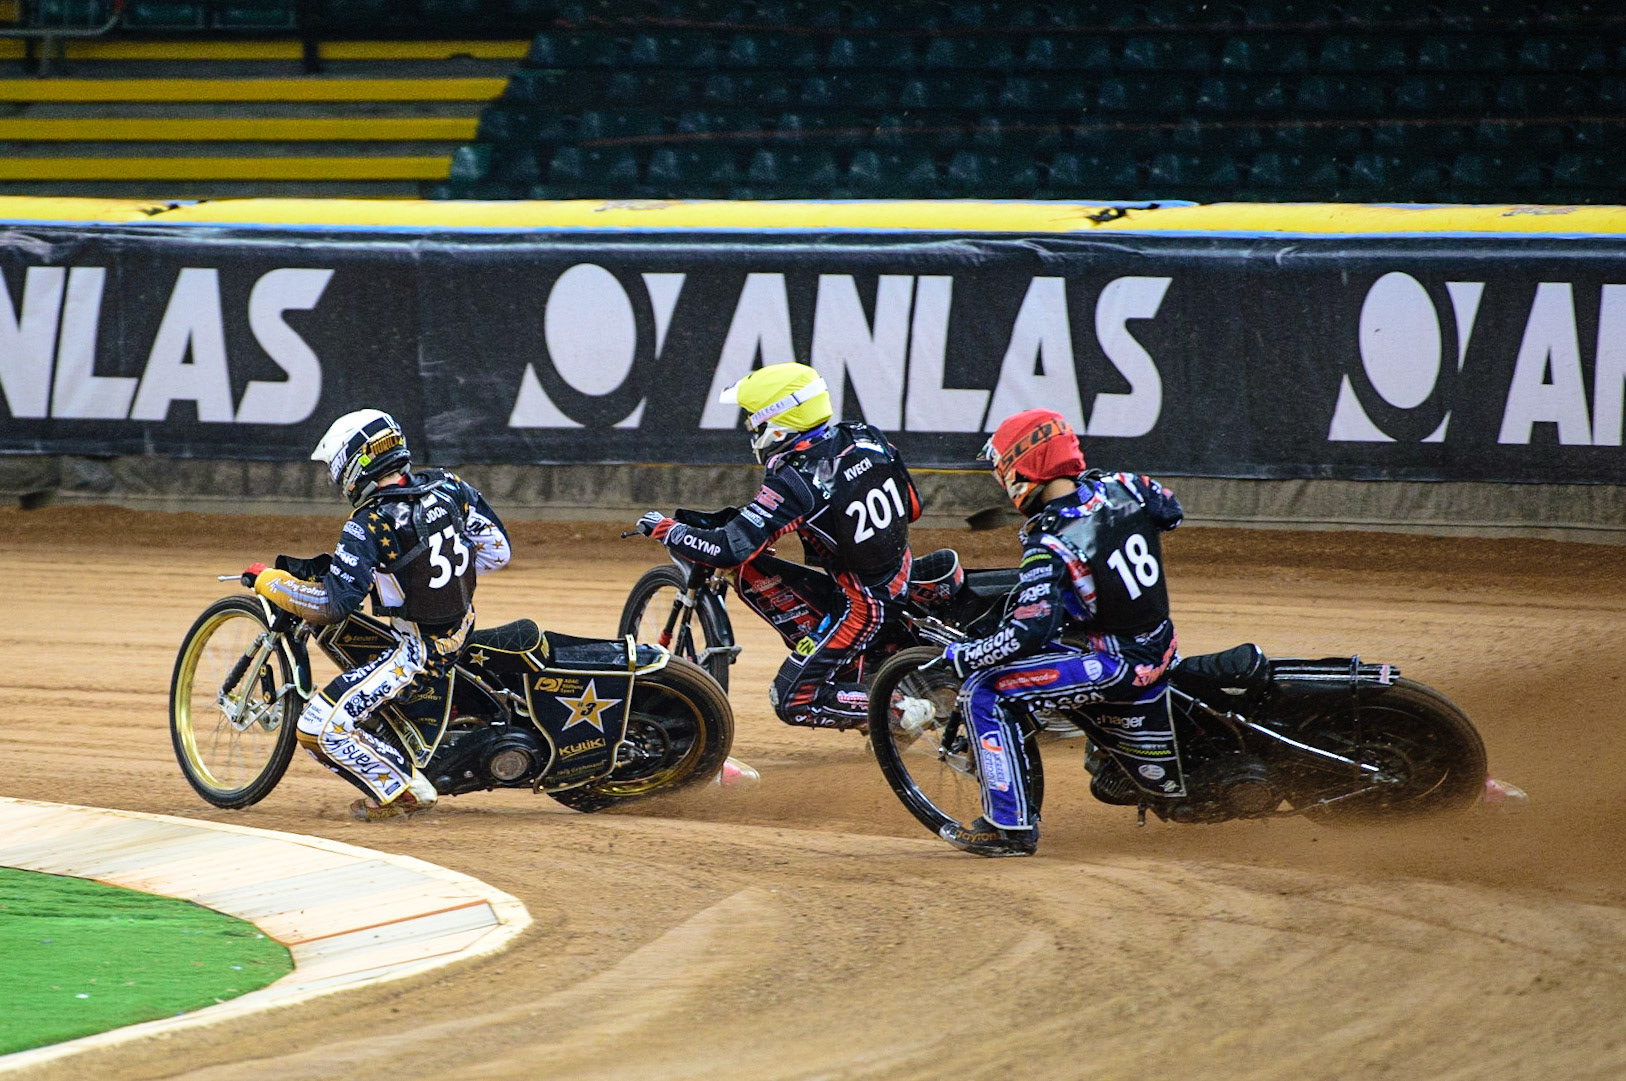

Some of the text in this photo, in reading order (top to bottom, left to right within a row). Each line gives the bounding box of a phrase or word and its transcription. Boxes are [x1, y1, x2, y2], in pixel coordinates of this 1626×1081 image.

[699, 272, 1173, 437] ANLAS
[843, 457, 873, 482] KVECH
[845, 477, 906, 544] 201
[428, 524, 470, 589] 33
[683, 534, 722, 557] OLYMP
[1107, 533, 1160, 600] 18
[964, 628, 1015, 662] HAGON
